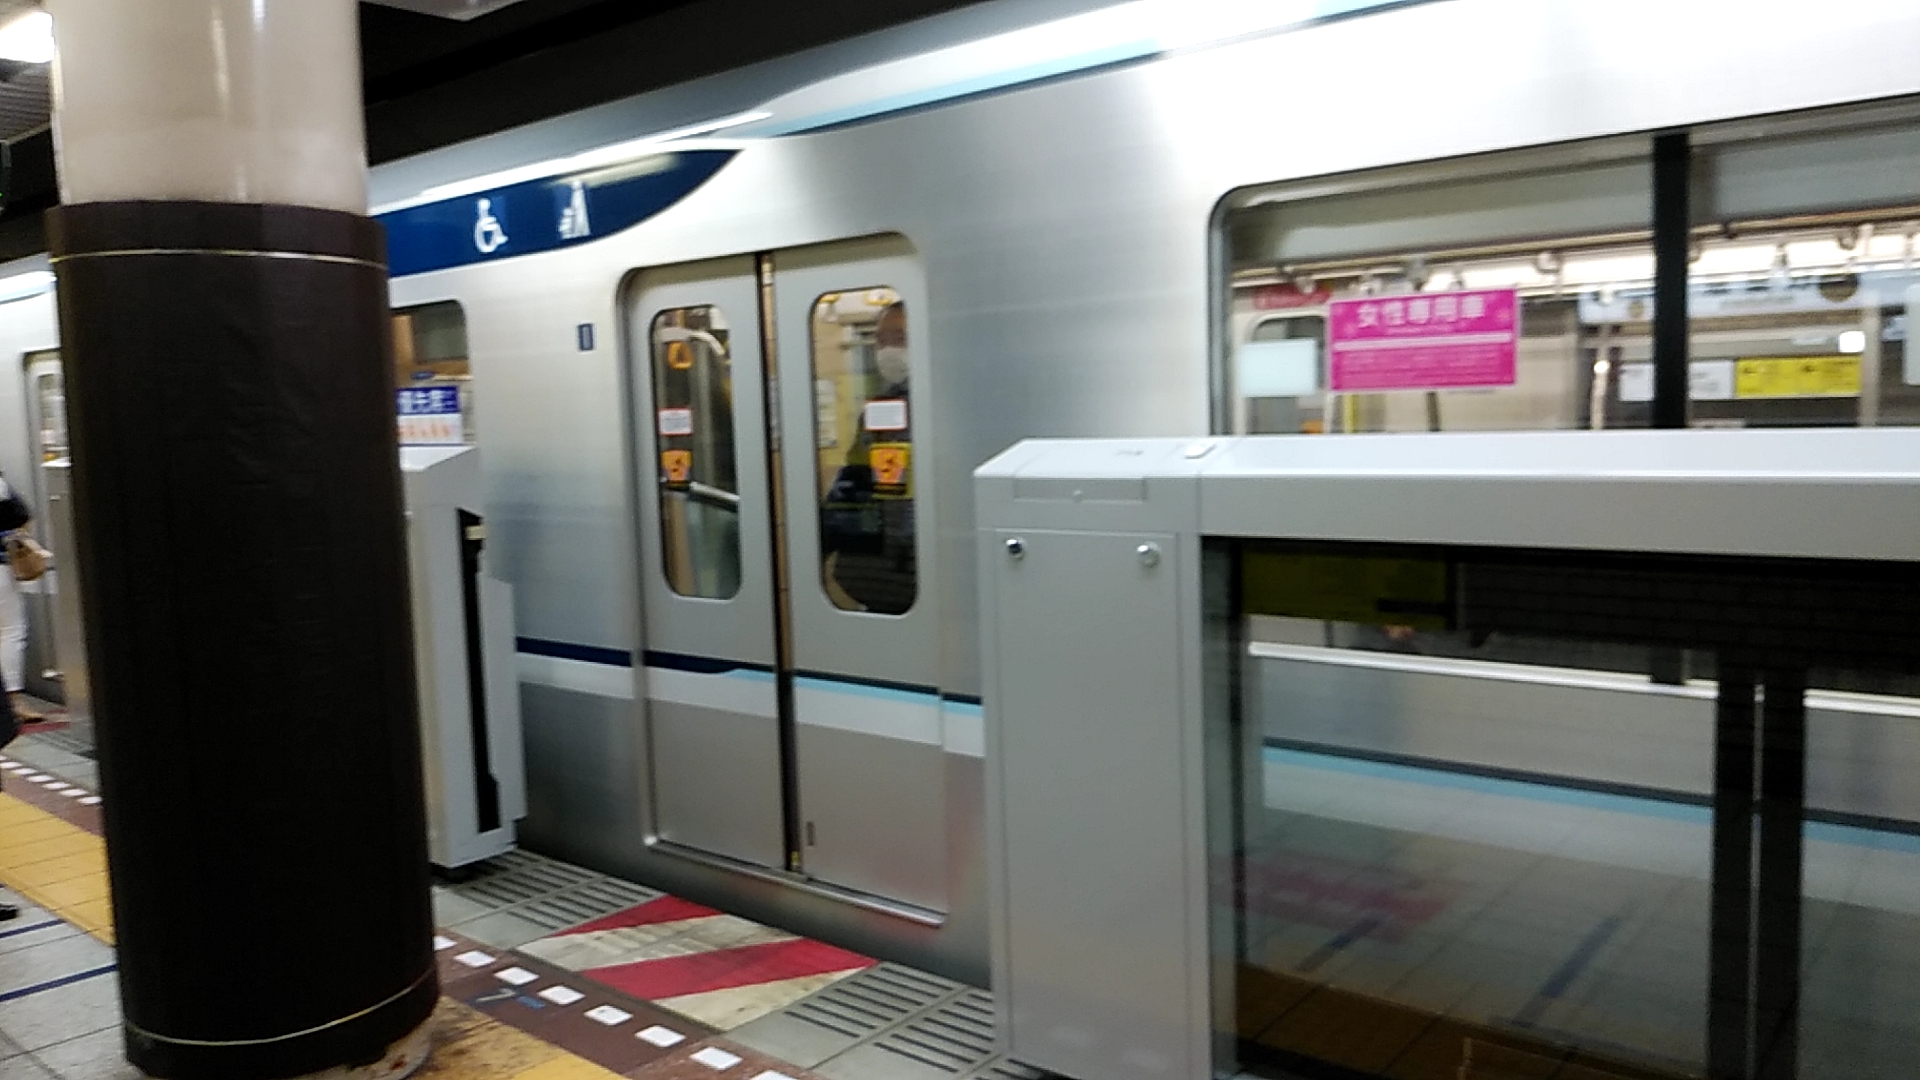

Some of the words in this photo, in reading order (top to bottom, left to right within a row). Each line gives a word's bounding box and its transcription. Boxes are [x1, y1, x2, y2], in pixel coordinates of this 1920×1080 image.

[1357, 296, 1484, 328] 女性専用車
